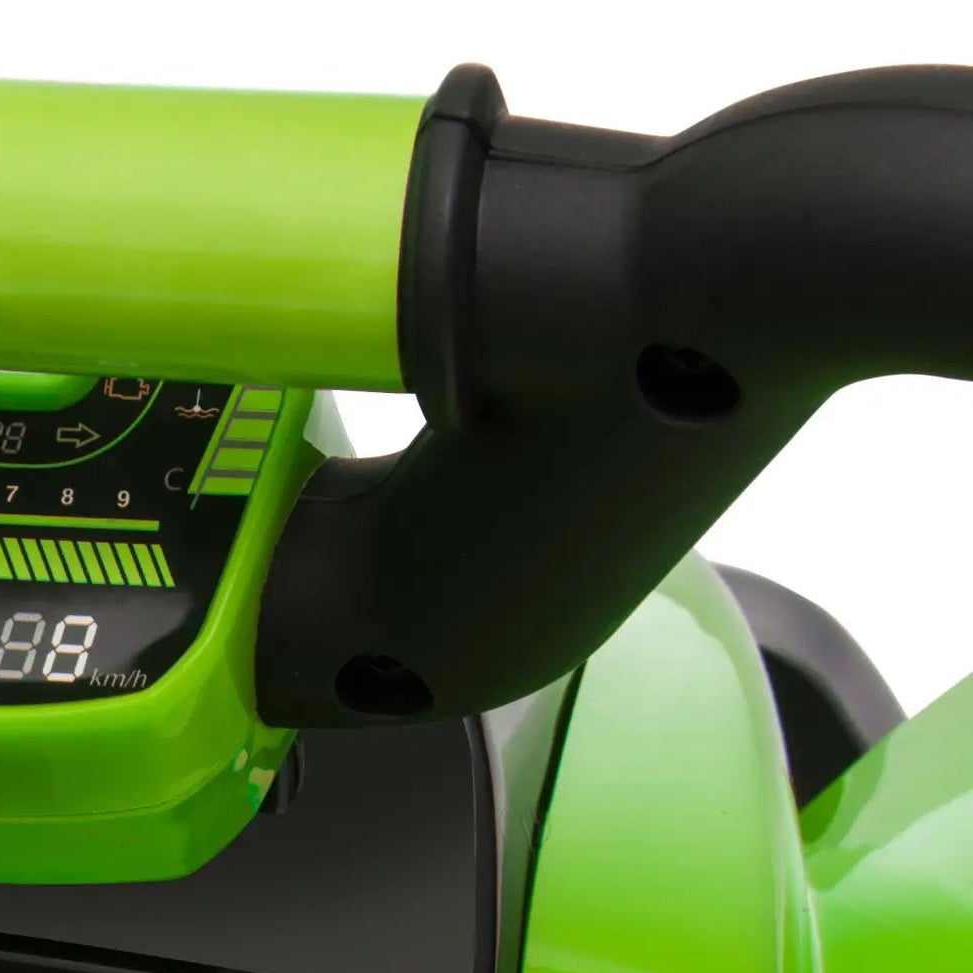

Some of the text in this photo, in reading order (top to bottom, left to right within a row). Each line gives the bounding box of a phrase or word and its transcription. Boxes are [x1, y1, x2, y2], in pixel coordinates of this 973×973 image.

[164, 467, 182, 491] C
[5, 485, 19, 502] 7
[61, 488, 74, 505] 8
[117, 490, 131, 507] 9
[89, 668, 148, 688] km/h
